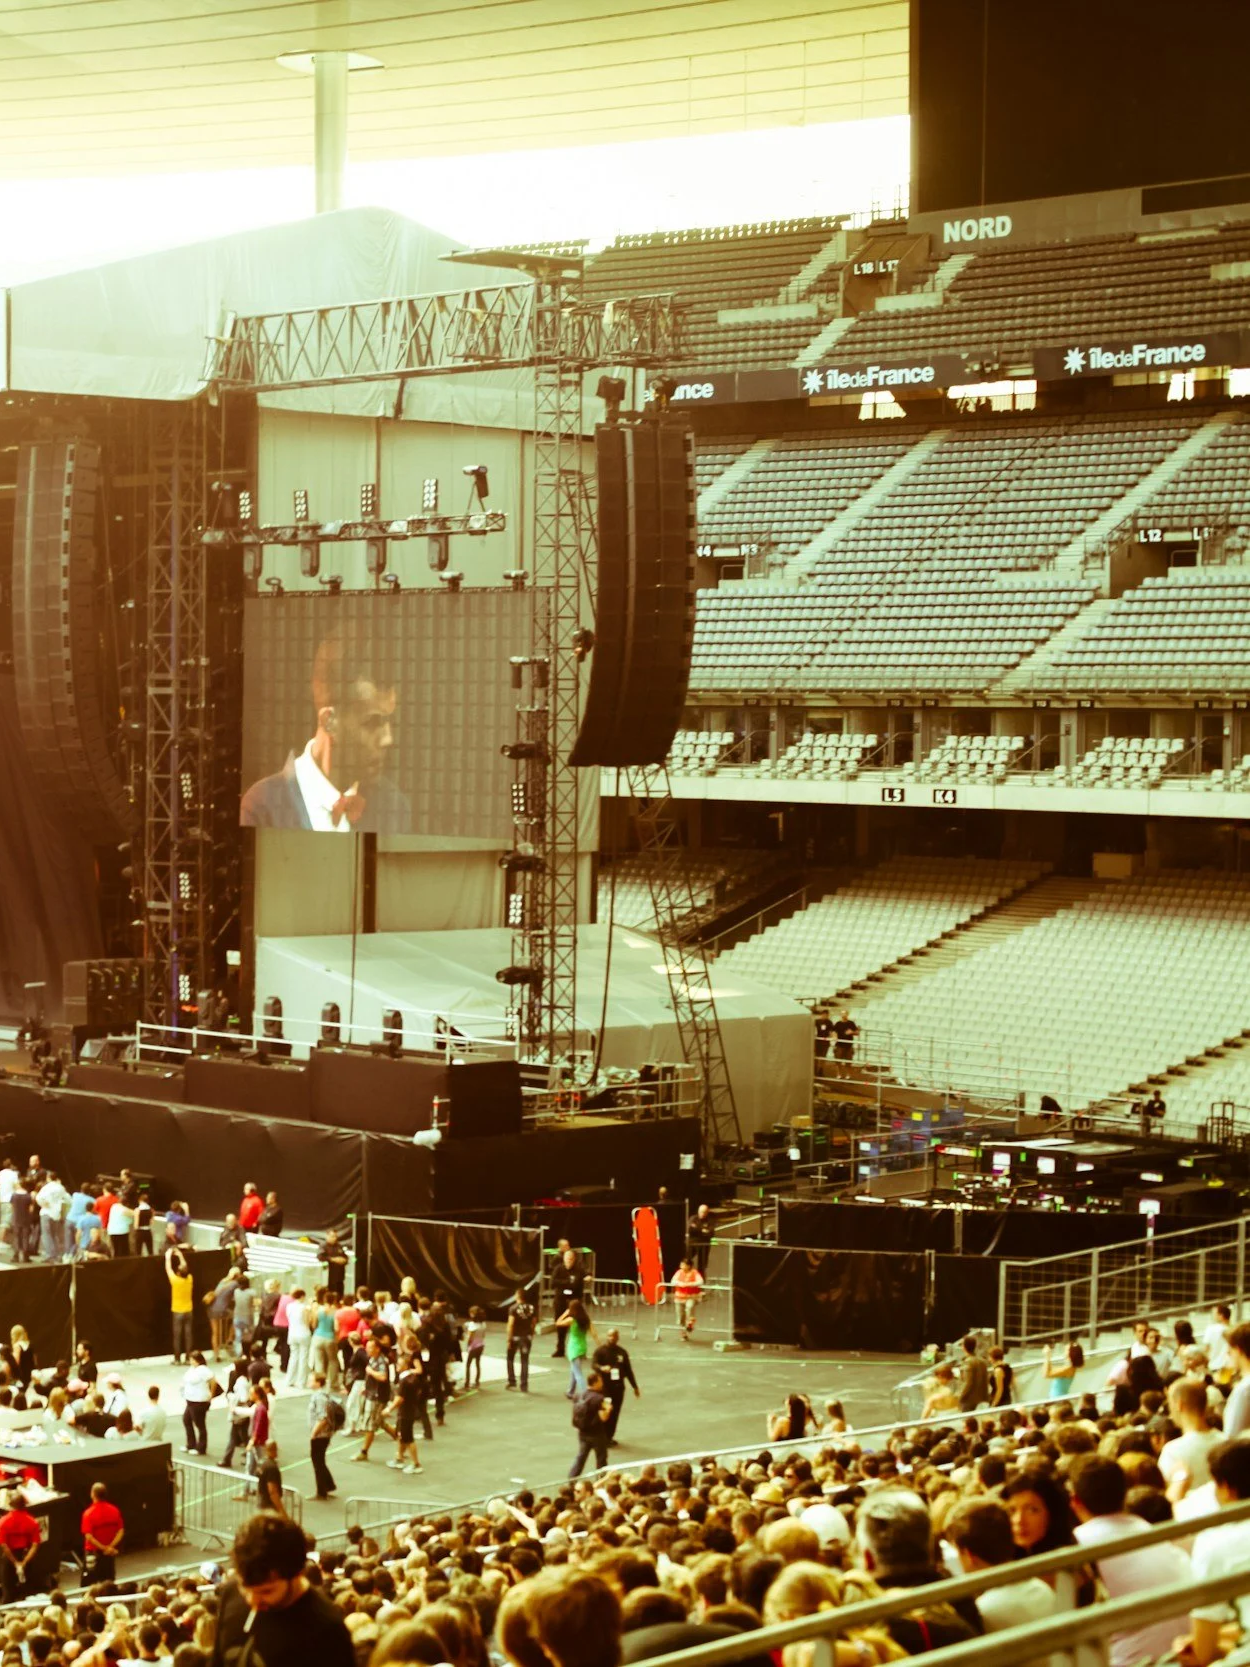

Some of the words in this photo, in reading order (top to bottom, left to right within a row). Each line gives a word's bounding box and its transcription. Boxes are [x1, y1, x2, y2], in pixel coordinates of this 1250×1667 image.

[943, 215, 1012, 243] NORD
[853, 262, 874, 275] L18
[1140, 528, 1162, 543] L12
[884, 788, 902, 802] L5
[935, 790, 954, 804] K4
